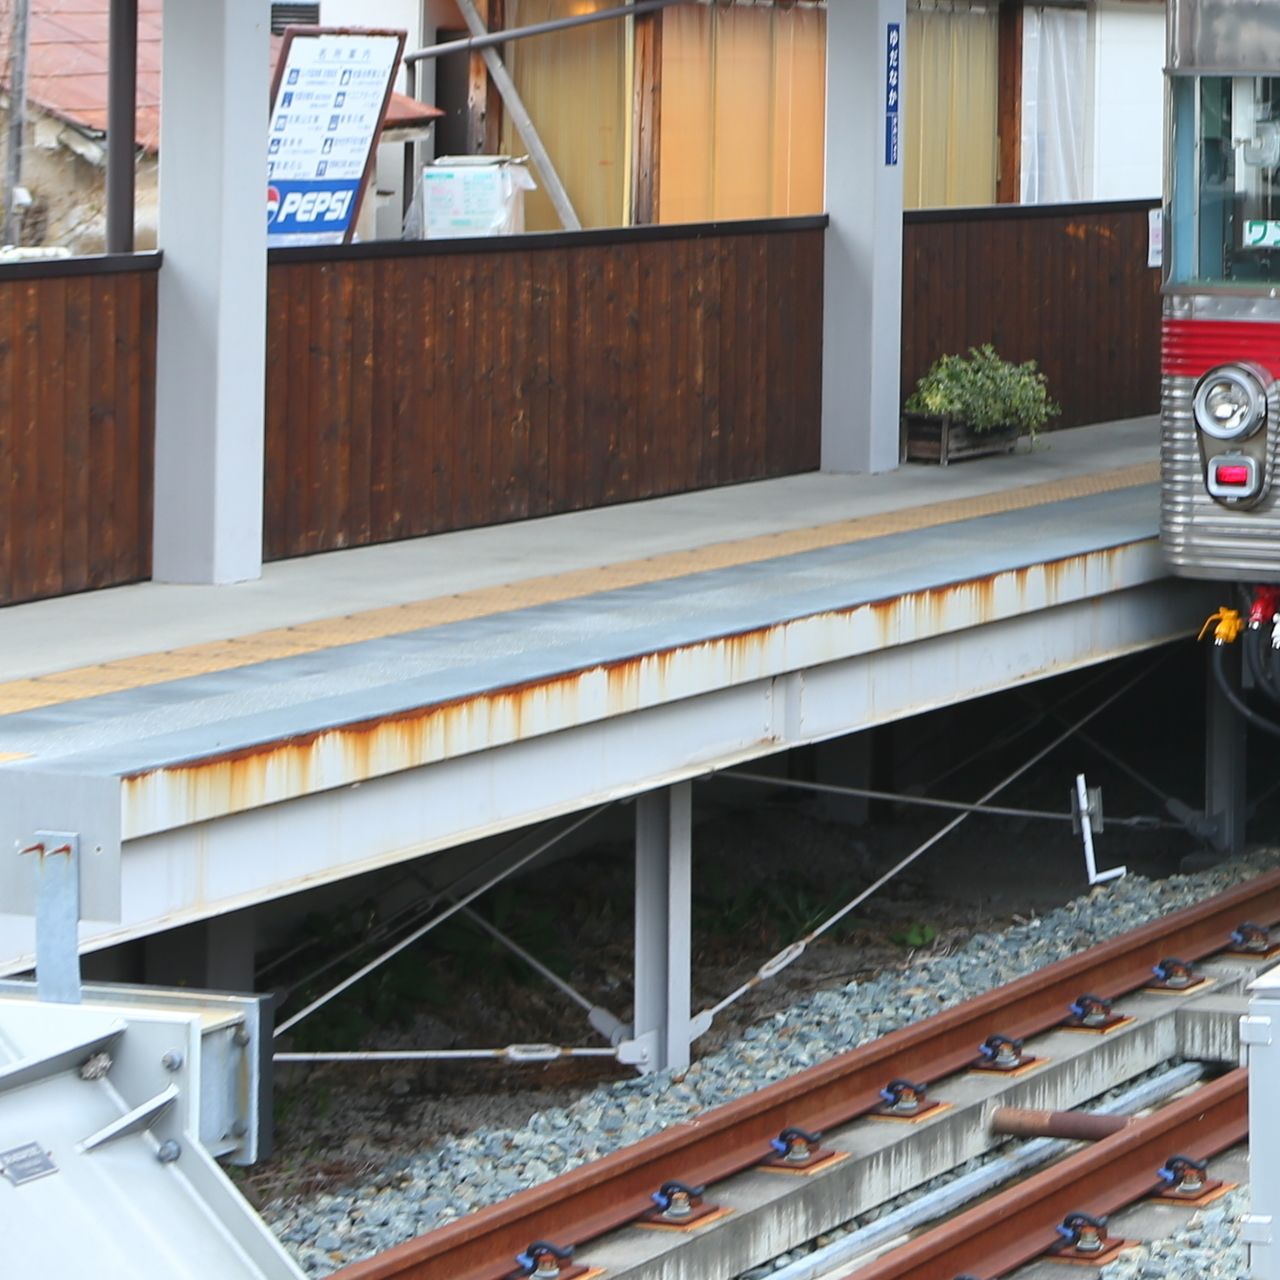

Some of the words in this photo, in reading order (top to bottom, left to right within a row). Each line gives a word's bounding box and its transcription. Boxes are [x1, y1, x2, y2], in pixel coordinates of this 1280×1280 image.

[888, 29, 899, 107] ゆだなか
[277, 190, 354, 223] PEPSI
